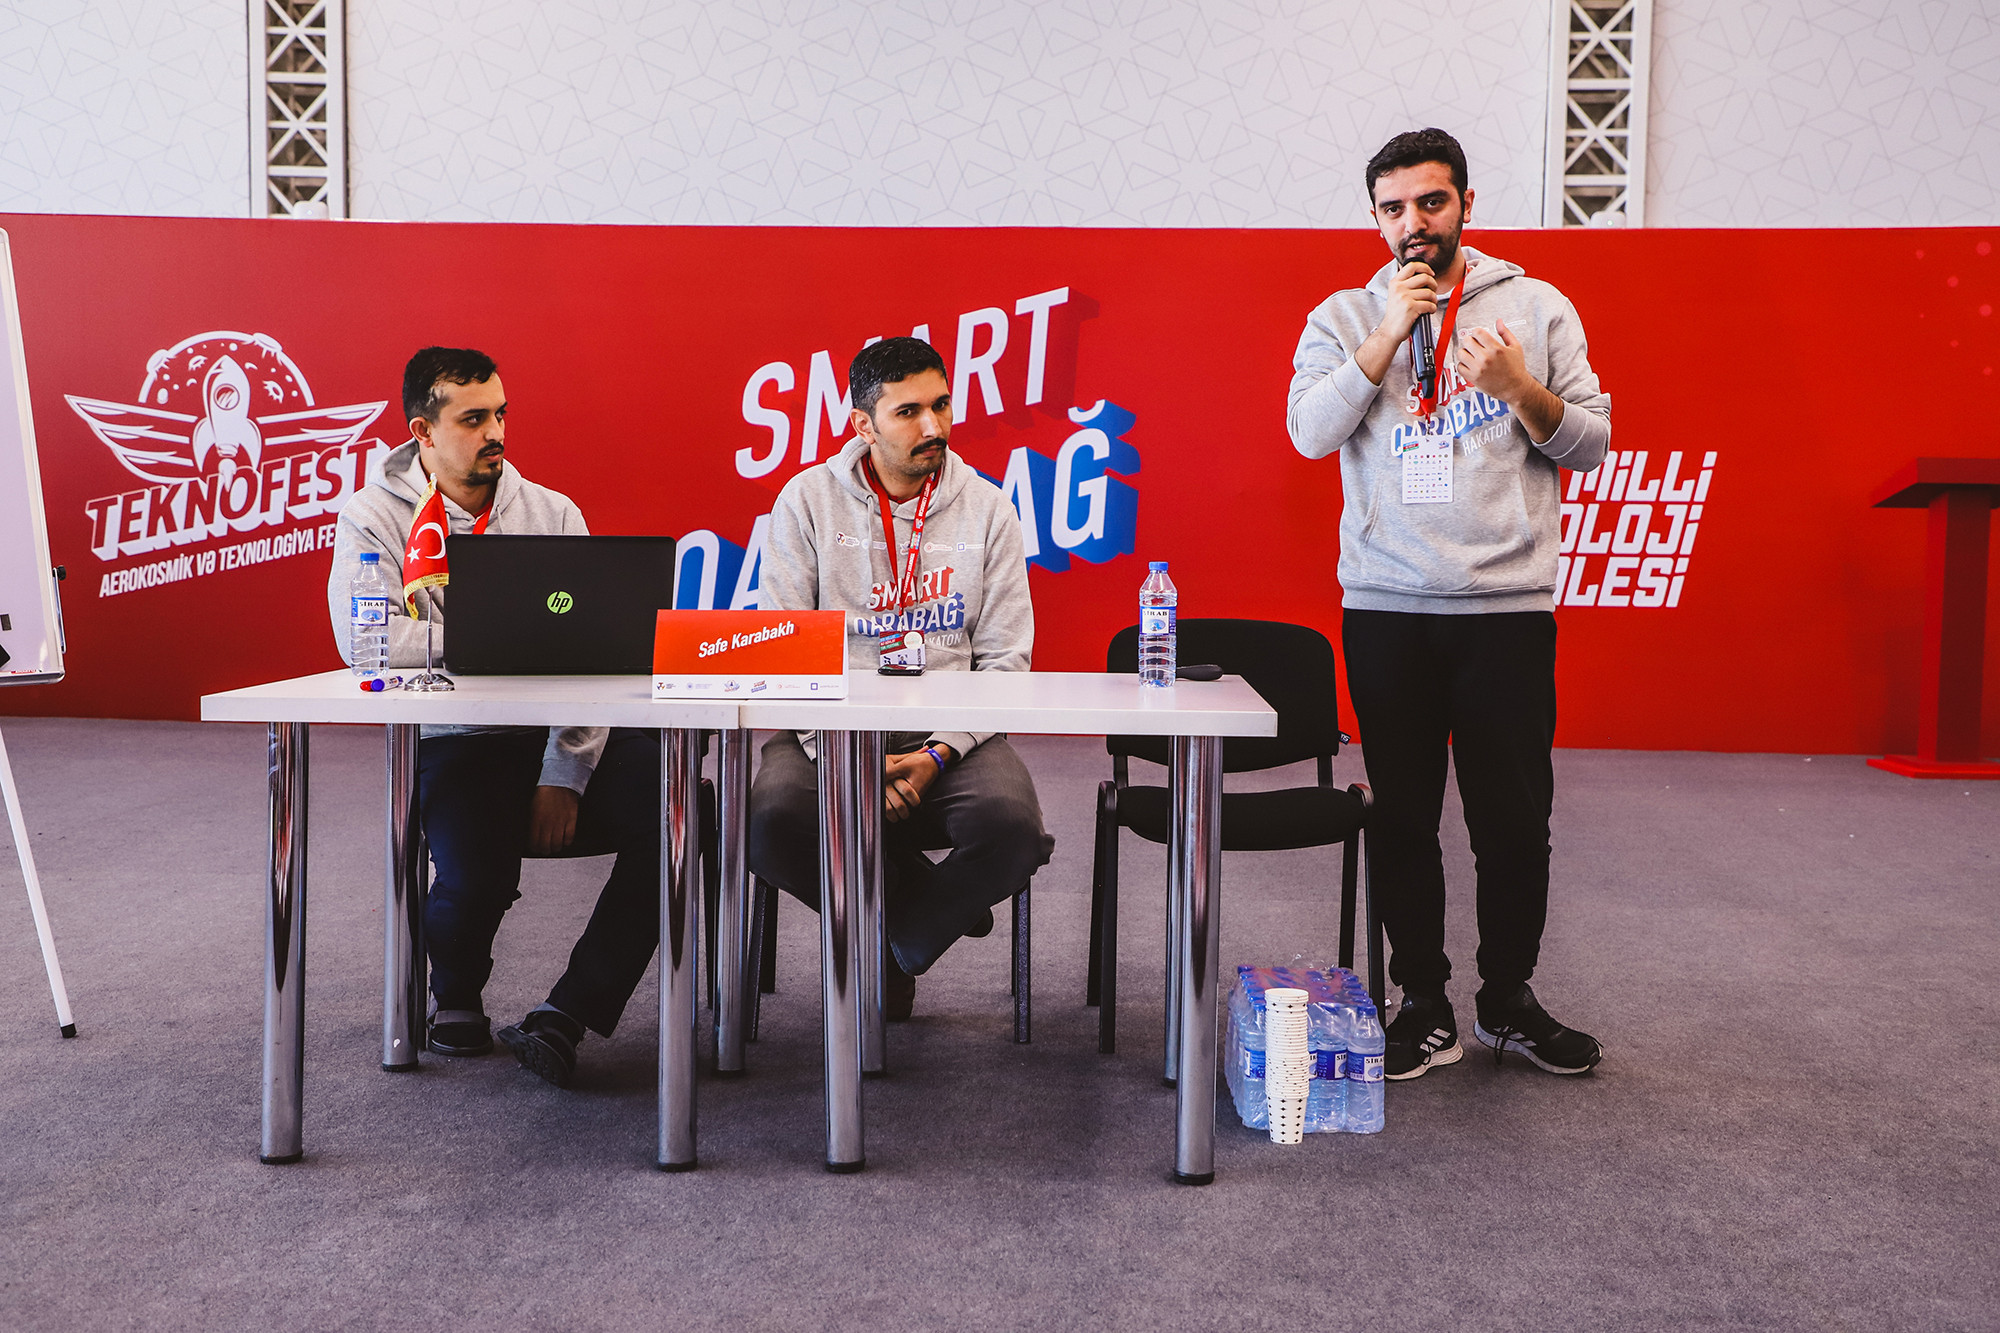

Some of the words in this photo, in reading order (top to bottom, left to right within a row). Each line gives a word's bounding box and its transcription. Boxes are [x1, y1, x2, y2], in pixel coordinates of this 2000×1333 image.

[734, 285, 1070, 480] SMRT
[1461, 418, 1512, 457] HAKATON
[85, 438, 388, 561] TEKNOFEST
[1559, 503, 1704, 555] OLOJİ
[98, 553, 195, 598] AEROKOSMİK
[218, 528, 315, 572] TEXNOLOGİYA
[1552, 556, 1690, 608] LESİ
[548, 590, 572, 614] hp
[698, 637, 729, 658] Safe
[731, 620, 795, 650] Karabakh
[924, 632, 963, 648] KATON
